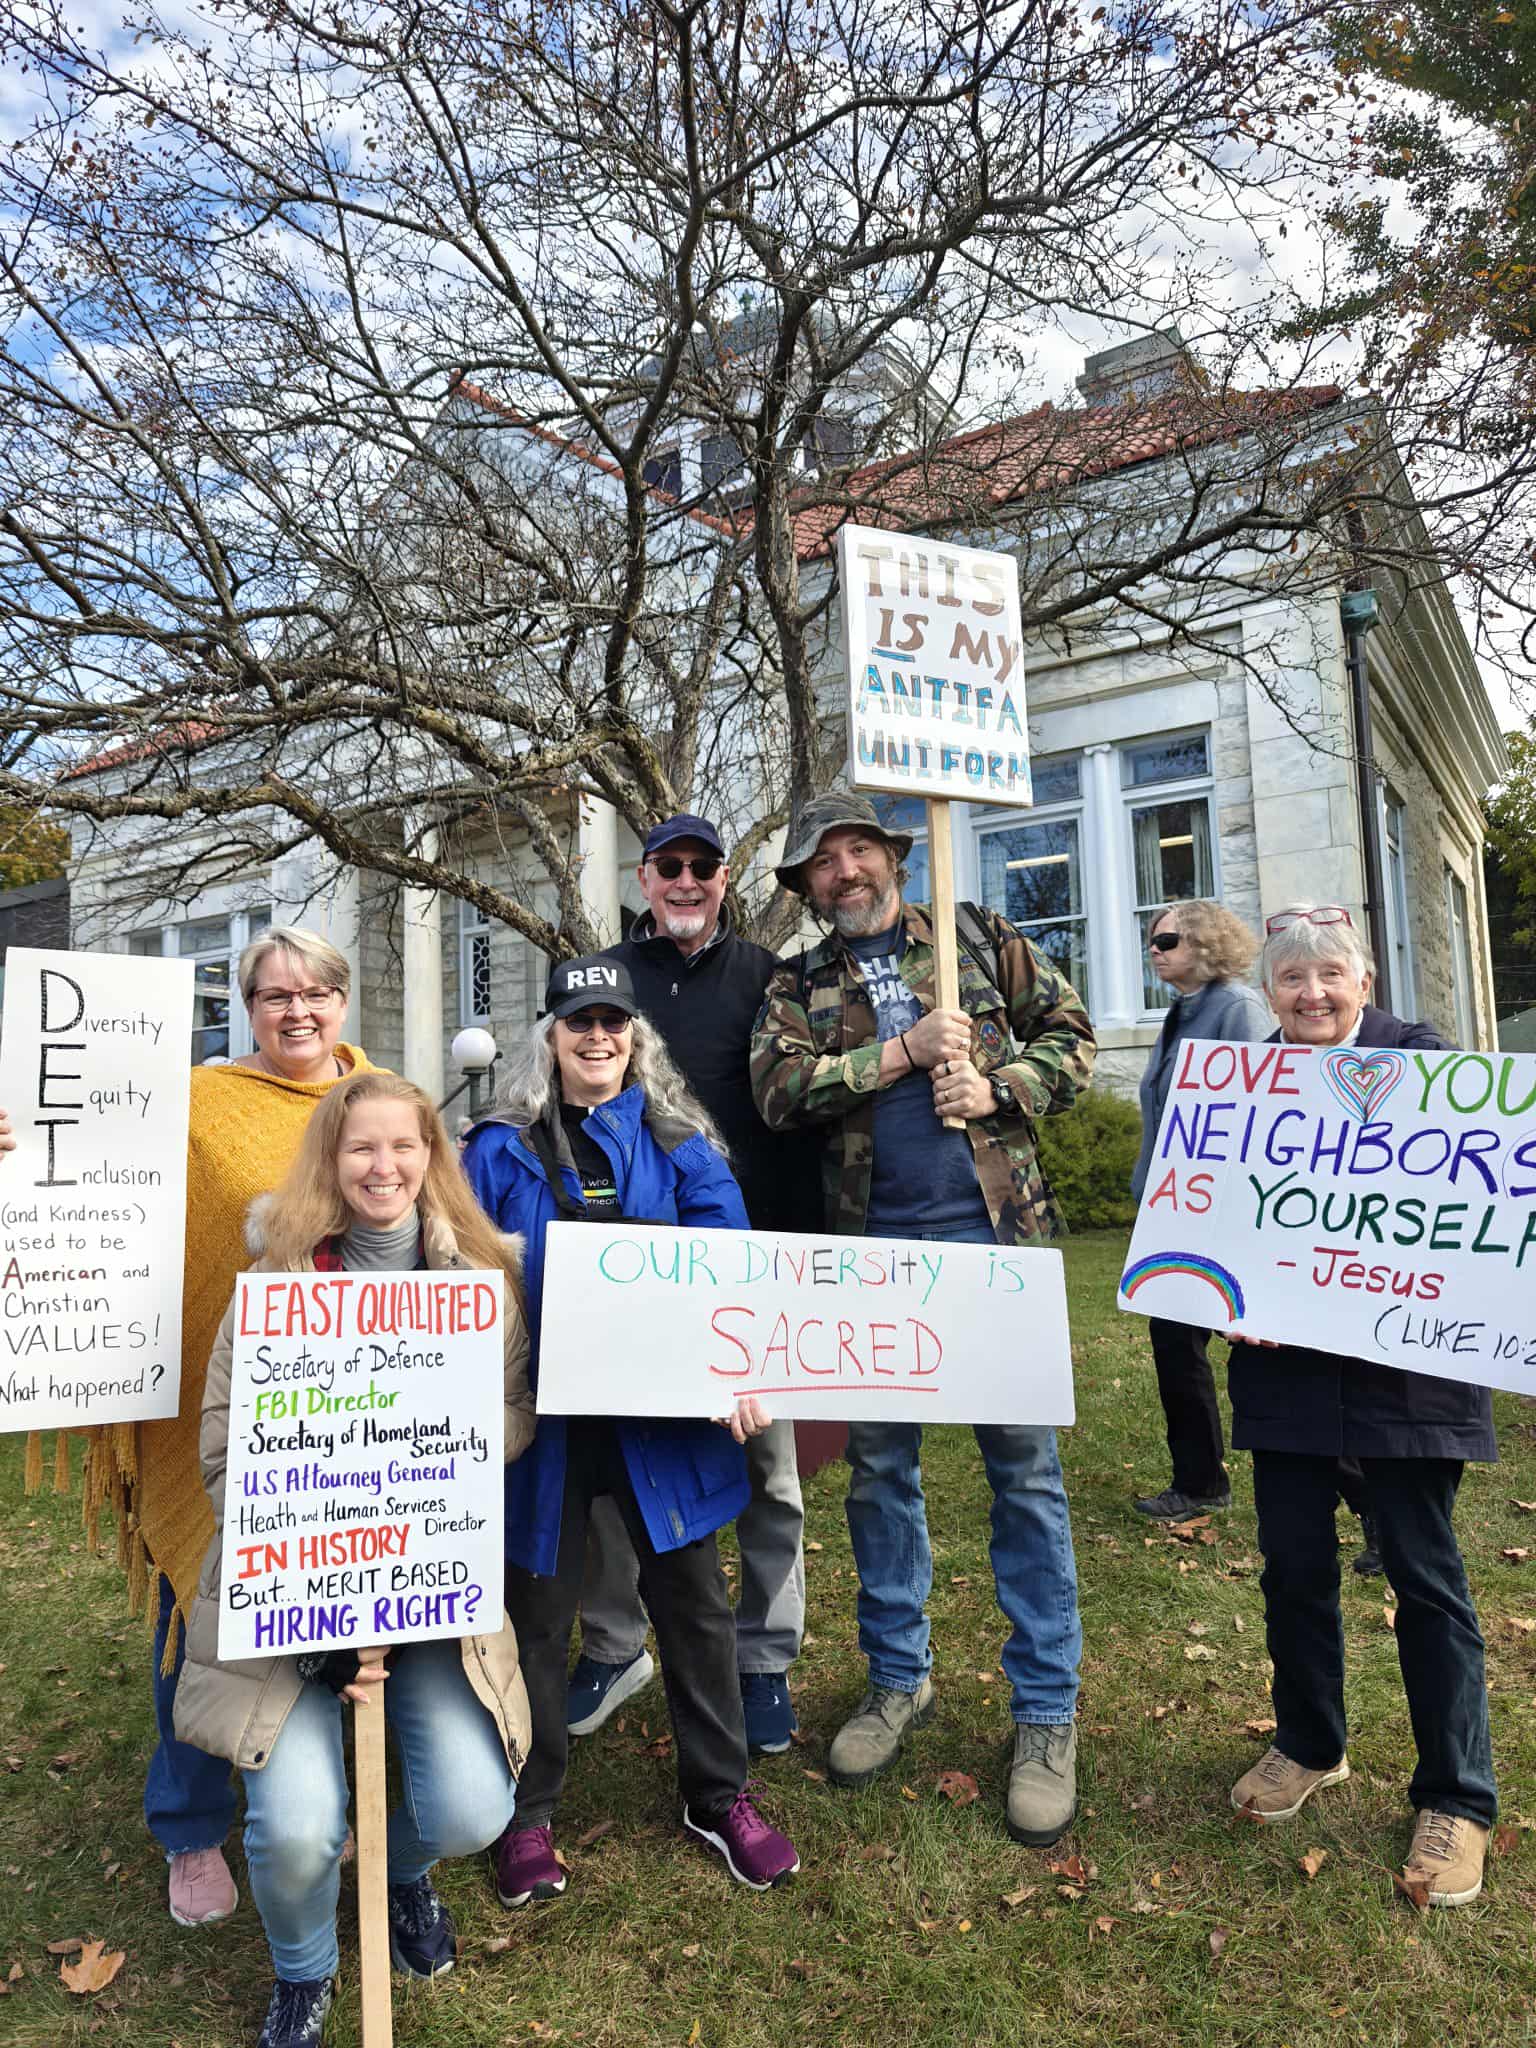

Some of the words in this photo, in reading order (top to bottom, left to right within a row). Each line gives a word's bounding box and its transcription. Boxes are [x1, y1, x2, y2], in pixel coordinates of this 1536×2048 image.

[857, 545, 1005, 616] THIS
[876, 608, 928, 651] IS
[950, 622, 1019, 684] MY
[855, 664, 1023, 736] ANTIFA
[857, 727, 1031, 792] UNIFORM
[567, 966, 618, 990] REV
[40, 969, 163, 1044] Diversity
[38, 1043, 151, 1117] Equity
[1176, 1042, 1312, 1096] LOVE
[33, 1119, 161, 1187] Inclusion
[1148, 1167, 1215, 1215] AS
[1, 1202, 39, 1229] (and
[49, 1203, 146, 1225] Kindness)
[5, 1233, 57, 1252] used
[66, 1234, 87, 1251] to
[100, 1232, 127, 1251] be
[599, 1240, 717, 1285] OUR
[1, 1257, 107, 1289] American
[122, 1264, 150, 1280] and
[3, 1292, 110, 1318] Christian
[240, 1279, 353, 1338] LEAST
[356, 1280, 498, 1336] QUALIFIED
[3, 1314, 161, 1356] VALUES!
[709, 1306, 943, 1377] SACRED
[1374, 1304, 1485, 1354] (LUKE
[344, 1346, 363, 1374] of
[369, 1340, 445, 1373] Defence
[49, 1364, 165, 1409] happened?
[308, 1380, 400, 1413] Director
[340, 1419, 358, 1446] of
[363, 1416, 452, 1447] Homeland
[410, 1426, 489, 1463] Security
[286, 1463, 382, 1496] Attourney
[388, 1457, 456, 1486] General
[302, 1508, 319, 1523] and
[323, 1498, 380, 1523] Human
[385, 1497, 447, 1515] Services
[425, 1510, 488, 1537] Director
[237, 1542, 288, 1580] IN
[299, 1523, 411, 1571] HISTORY
[307, 1568, 382, 1600] MERIT
[391, 1560, 469, 1593] BASED
[254, 1605, 359, 1649] HIRING
[373, 1584, 483, 1634] RIGHT?
